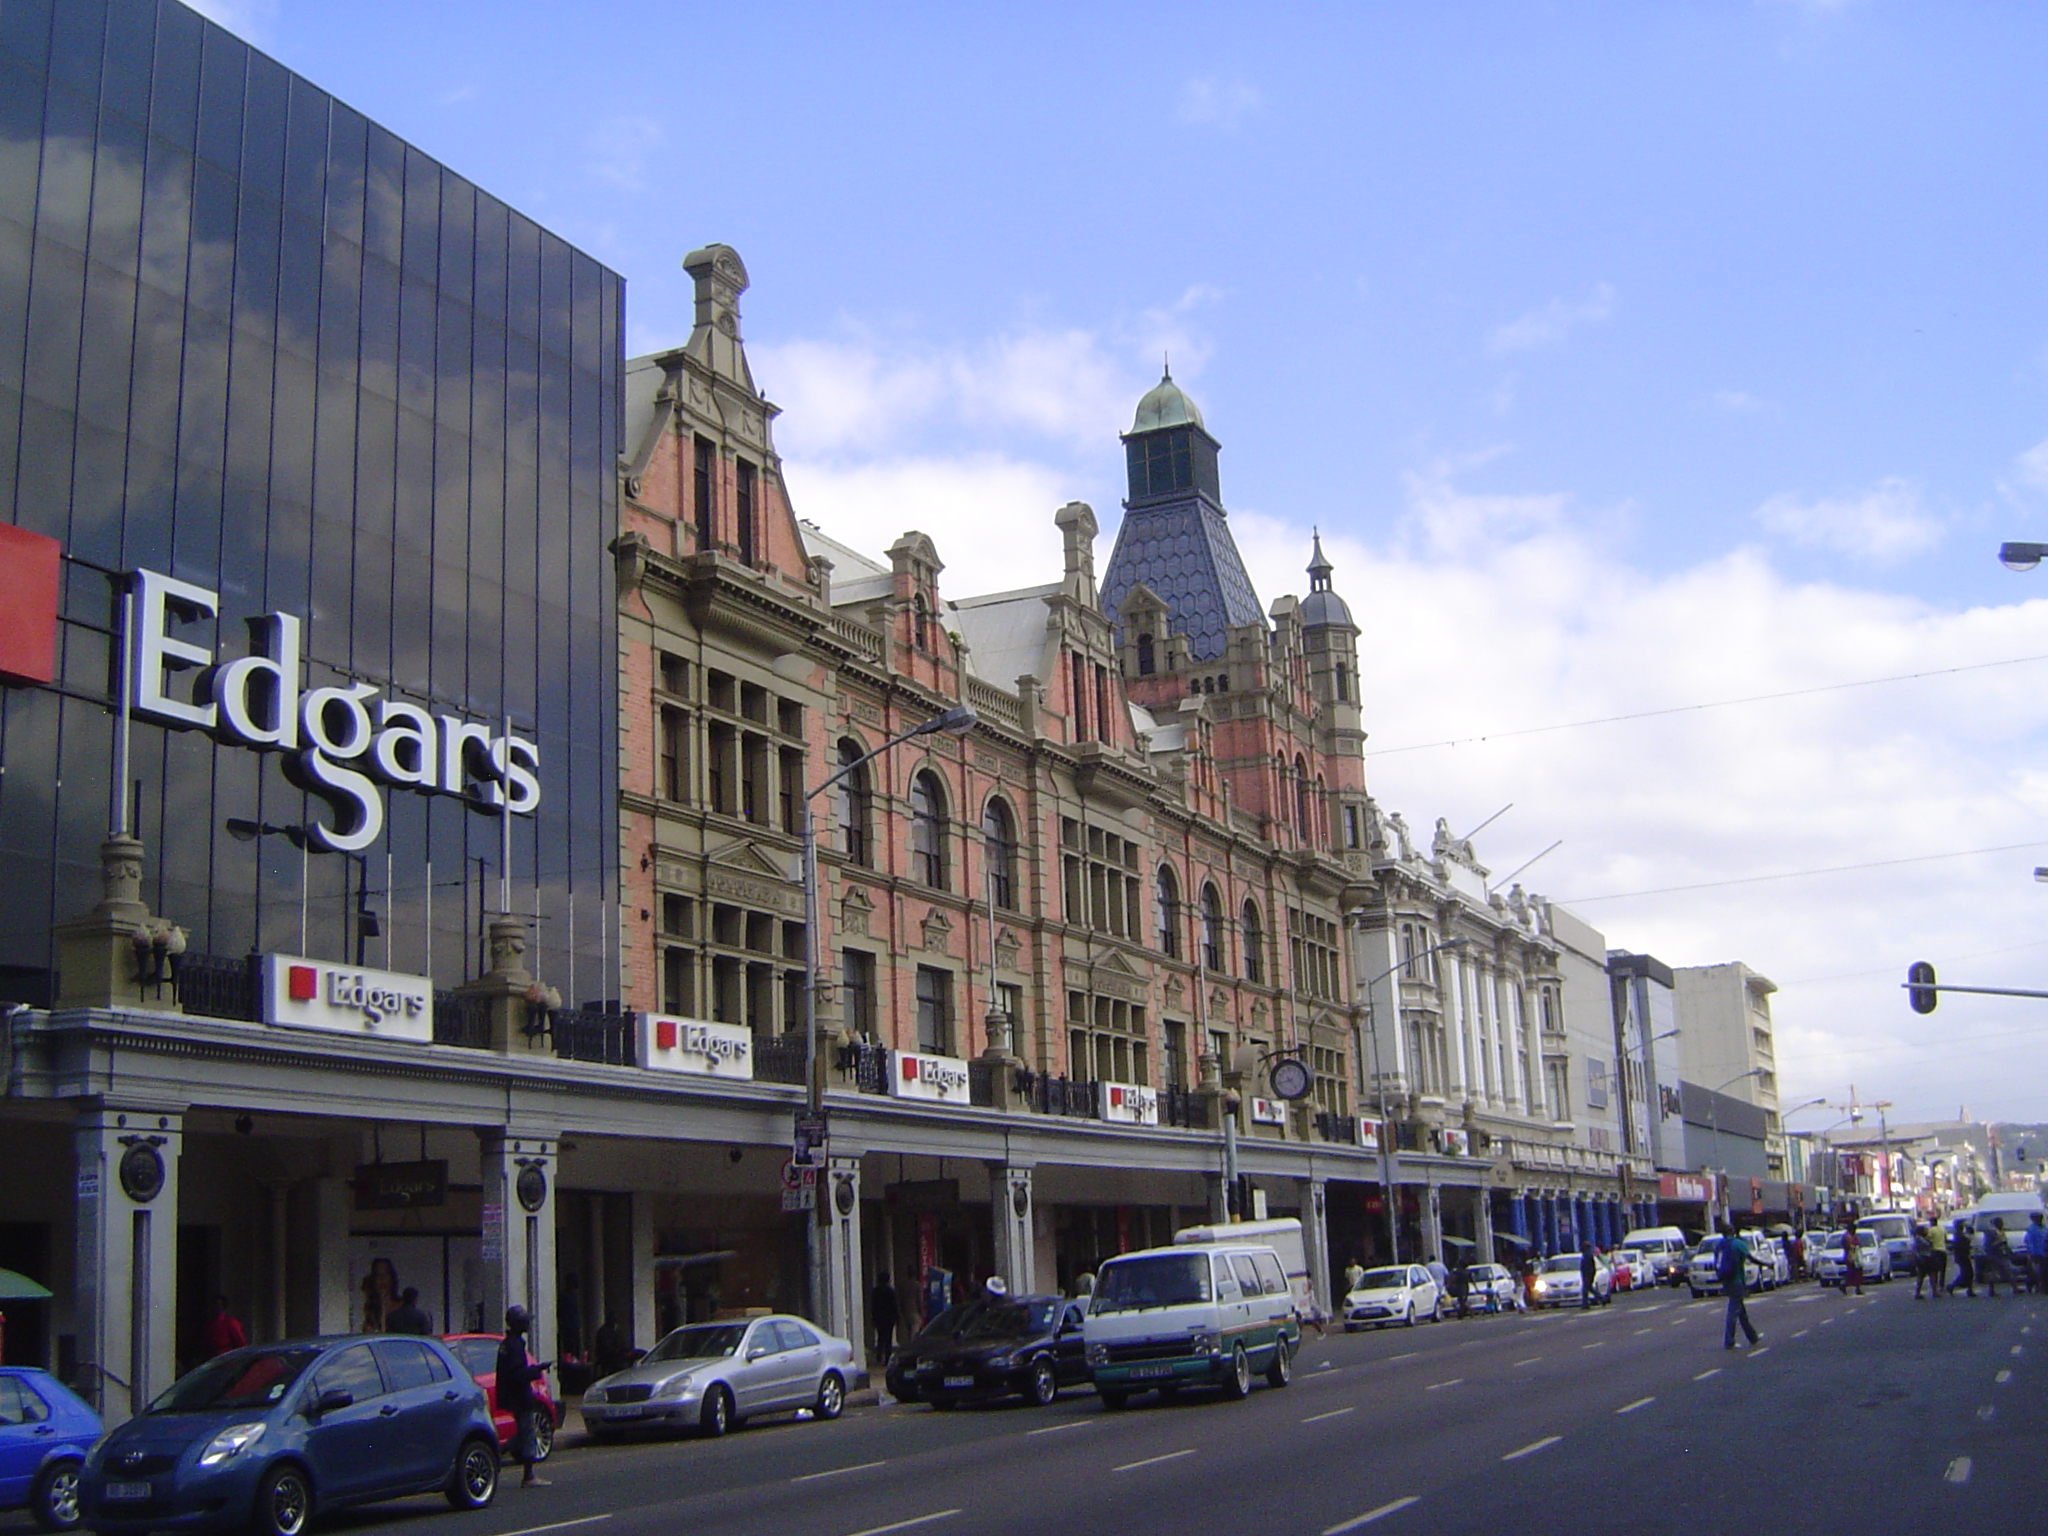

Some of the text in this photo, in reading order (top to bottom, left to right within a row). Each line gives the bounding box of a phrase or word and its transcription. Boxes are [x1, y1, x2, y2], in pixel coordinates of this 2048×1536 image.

[135, 568, 540, 850] Edgars
[327, 972, 424, 1029] Edgars
[681, 1024, 747, 1069] Edgars
[919, 1059, 967, 1098] Edgars
